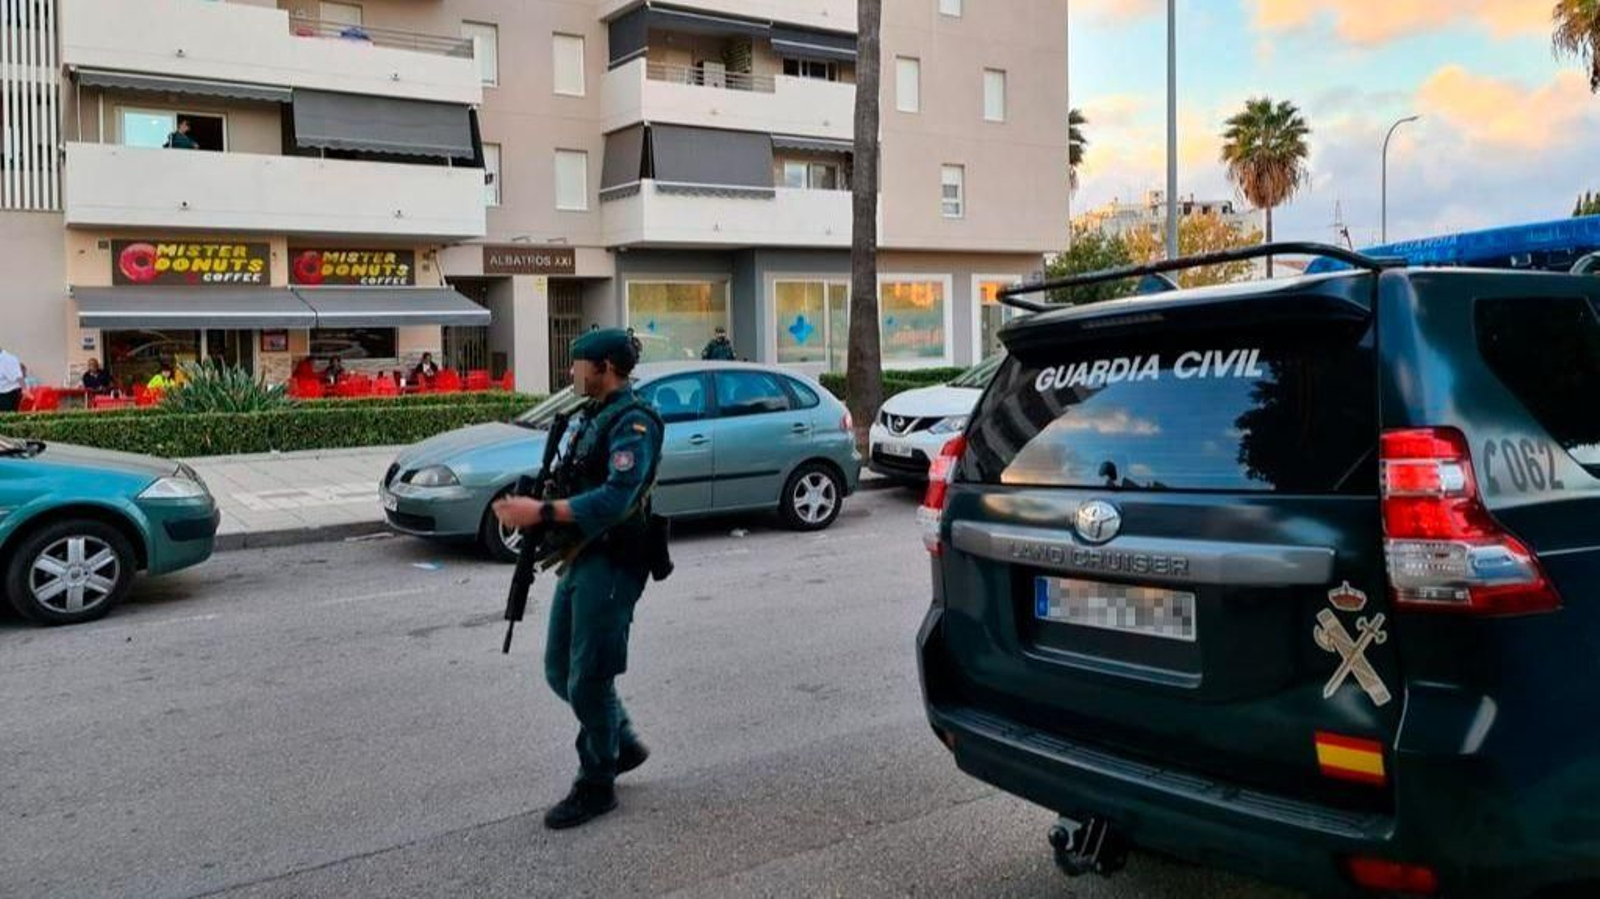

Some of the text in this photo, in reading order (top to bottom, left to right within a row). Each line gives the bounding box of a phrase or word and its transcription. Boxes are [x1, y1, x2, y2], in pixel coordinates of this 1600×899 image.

[156, 243, 248, 257] MISTER
[322, 251, 397, 263] MISTER
[490, 255, 551, 267] ALBATROS
[154, 257, 264, 272] DONUTS
[321, 263, 409, 276] DONUTS
[203, 273, 262, 282] COFFEE
[360, 277, 407, 285] COFFEE
[1034, 348, 1263, 392] GUARDIA CIVIL
[1501, 438, 1564, 492] 062
[1011, 544, 1190, 576] LAND CRUISER
